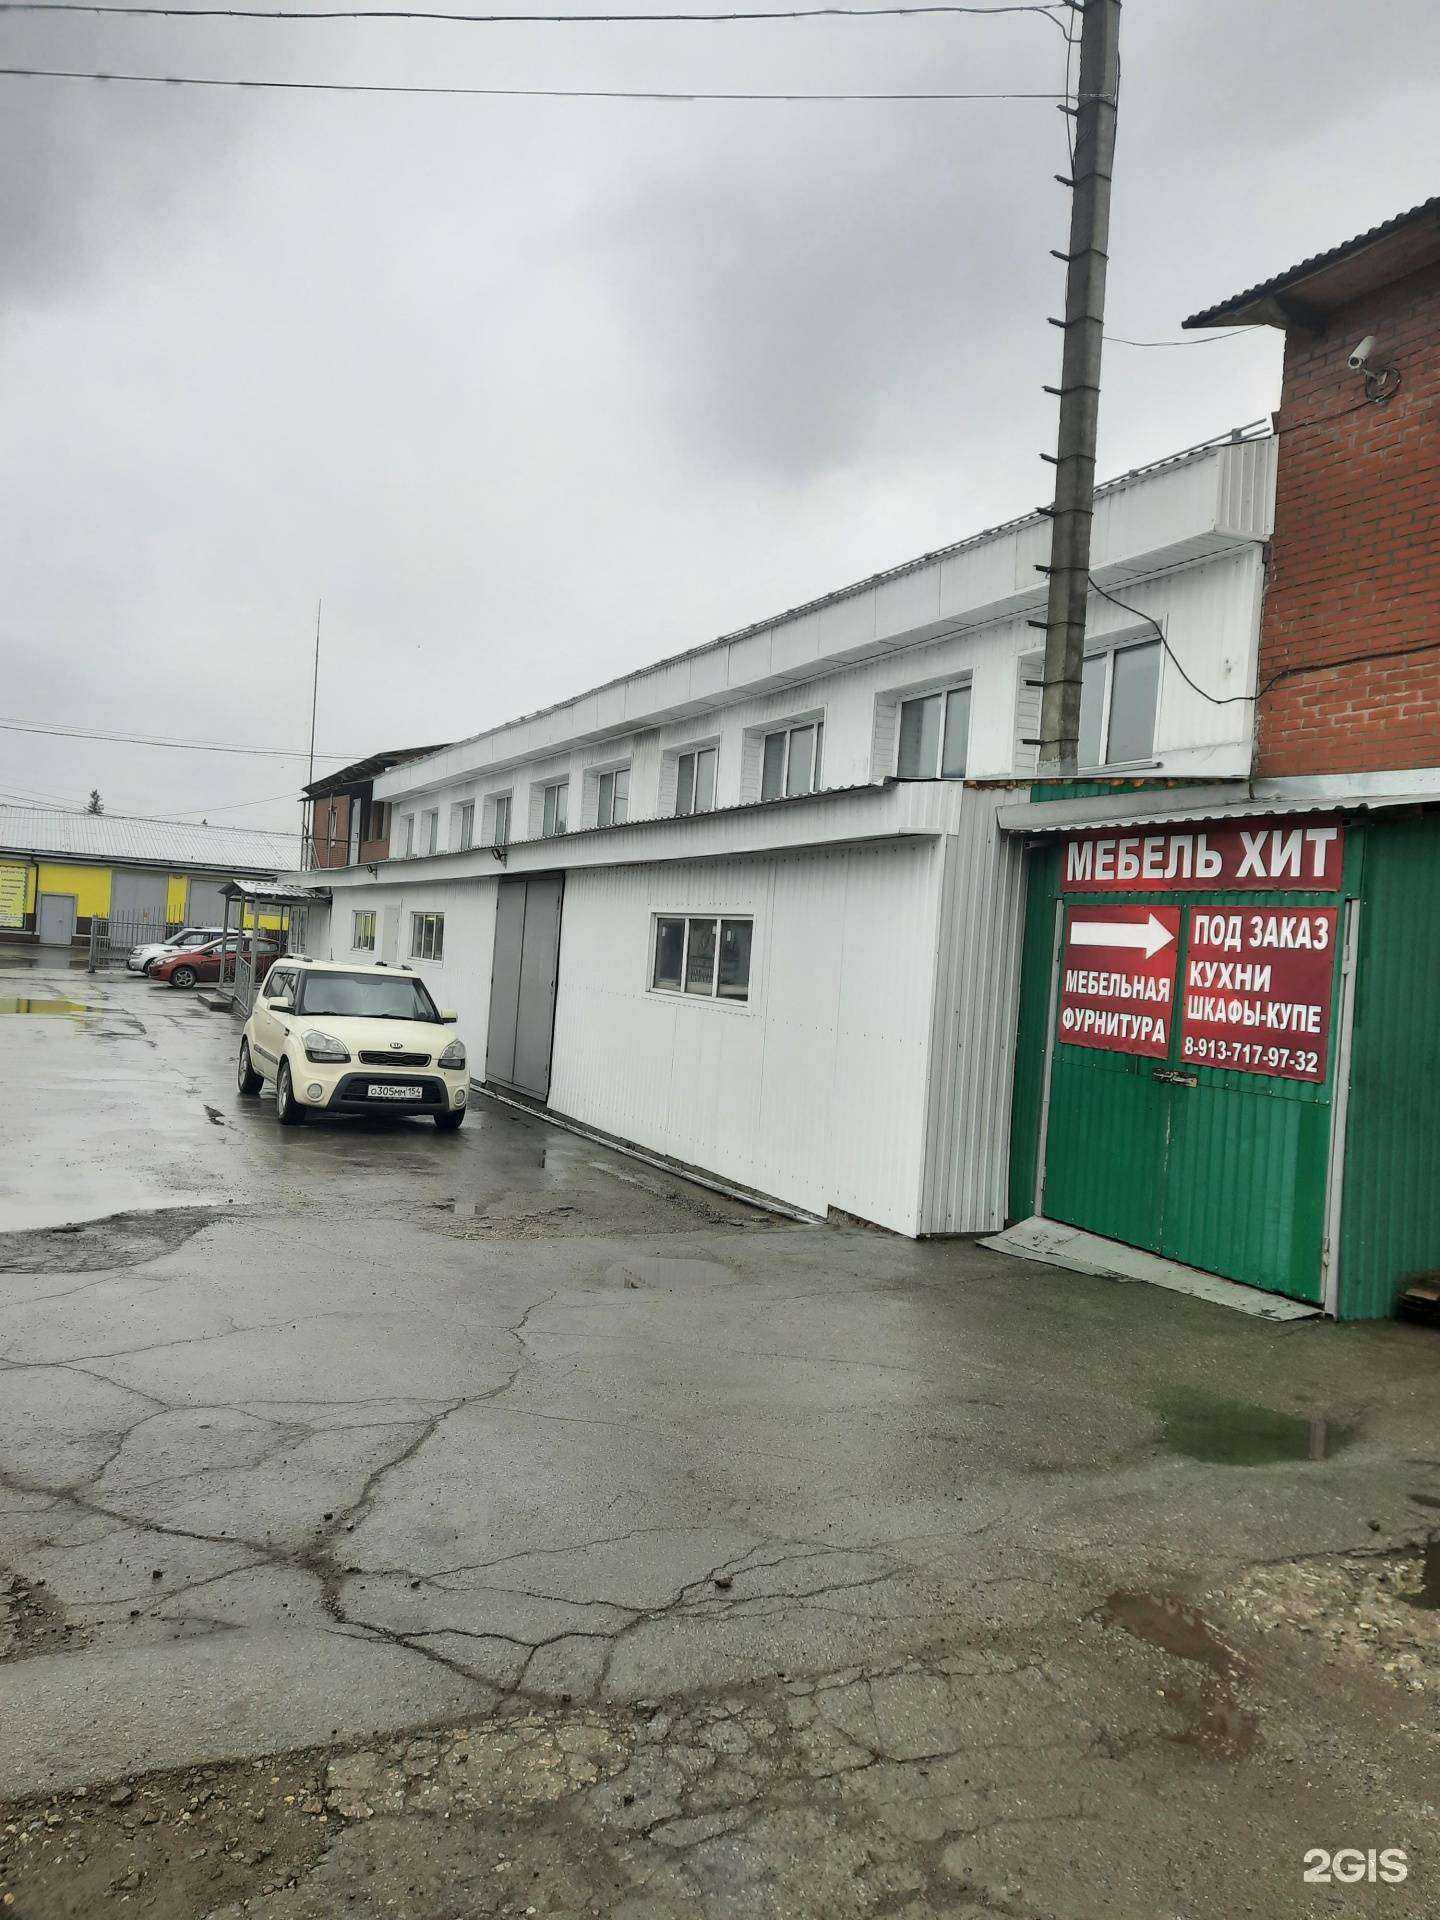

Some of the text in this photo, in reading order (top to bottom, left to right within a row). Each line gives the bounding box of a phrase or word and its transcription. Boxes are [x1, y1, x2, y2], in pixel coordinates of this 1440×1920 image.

[1066, 827, 1338, 881] МЕБЕЛЬ ХИТ
[1194, 914, 1330, 952] ПОД ЗАКАЗ
[1065, 969, 1171, 1003] МЕБЕЛЬНАЯ
[1189, 961, 1272, 993] КУХНИ
[1062, 1007, 1167, 1044] ФУРНИТУРА
[1186, 995, 1322, 1034] ШКАФЫ-КУПЕ
[1184, 1036, 1319, 1074] 8-913-717-97-32
